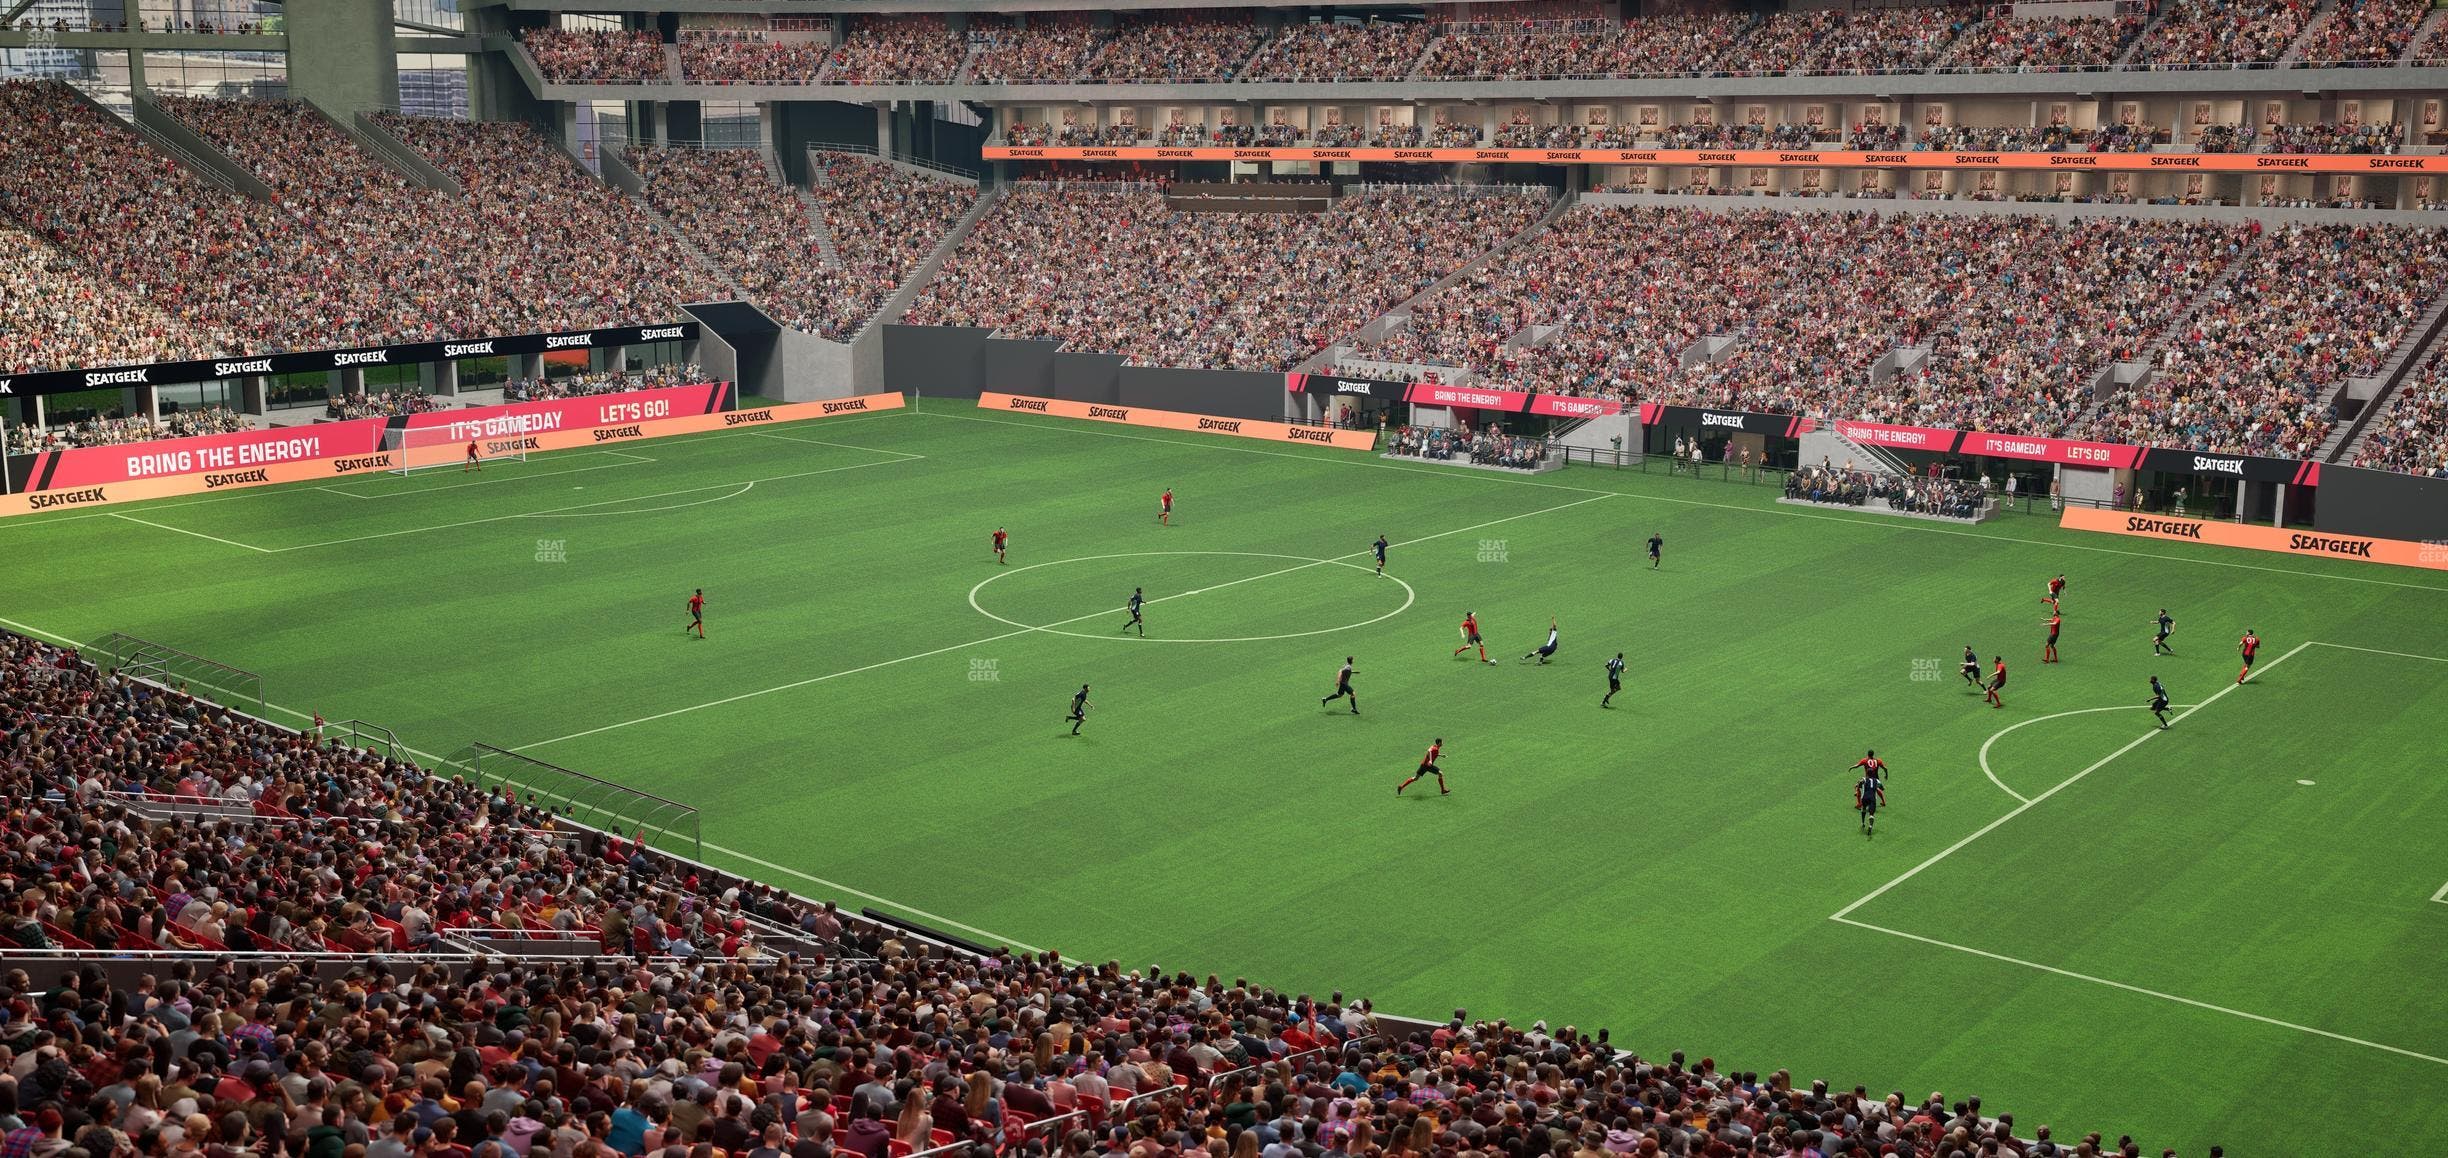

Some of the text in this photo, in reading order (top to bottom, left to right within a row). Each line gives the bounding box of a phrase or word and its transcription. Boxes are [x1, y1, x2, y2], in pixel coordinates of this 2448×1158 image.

[1009, 149, 1044, 157] SEATGEEK
[1082, 149, 1118, 157] SEATGEEK
[1157, 149, 1193, 158] SEATGEEK
[1234, 150, 1271, 158] SEATGEEK
[1313, 150, 1351, 158] SEATGEEK
[1393, 151, 1433, 159] SEATGEEK
[1476, 151, 1510, 160] SEATGEEK
[1546, 151, 1581, 160] SEATGEEK
[1620, 152, 1657, 161] SEATGEEK
[1698, 152, 1736, 162] SEATGEEK
[1779, 153, 1819, 163] SEATGEEK
[1865, 154, 1907, 164] SEATGEEK
[1955, 155, 2000, 165] SEATGEEK
[2050, 155, 2097, 166] SEATGEEK
[2150, 156, 2200, 167] SEATGEEK
[2256, 157, 2309, 168] SEATGEEK
[2369, 158, 2425, 169] SEATGEEK
[546, 333, 593, 349] SEATGEEK
[640, 326, 684, 341] SEATGEEK
[444, 341, 494, 357] SEATGEEK
[334, 350, 388, 366] SEATGEEK
[215, 358, 273, 376] SEATGEEK
[85, 368, 148, 387] SEATGEEK
[1337, 380, 1371, 395] SEATGEEK
[1010, 397, 1048, 412] SEATGEEK
[1434, 390, 1502, 406] BRING THE ENERGY!
[600, 399, 669, 423] LET'S GO!
[822, 399, 868, 414] SEATGEEK
[1088, 406, 1129, 421] SEATGEEK
[1552, 400, 1567, 412] IT'S
[450, 410, 563, 440] IT'S GAMEDAY
[724, 409, 774, 426] SEATGEEK
[1702, 412, 1745, 429] SEATGEEK
[593, 424, 643, 442] SEATGEEK
[1197, 417, 1242, 434] SEATGEEK
[1287, 427, 1335, 444] SEATGEEK
[1846, 427, 1926, 445] BRING THE ENERGY!
[1986, 439, 2047, 456] IT'S GAMEDAY
[2067, 446, 2110, 462] LET'S GO!
[127, 437, 320, 477] BRING THE ENERGY!
[2193, 456, 2244, 475] SEATGEEK
[204, 468, 270, 489] SEATGEEK
[28, 487, 107, 510] SEATGEEK
[2126, 516, 2203, 540] SEATGEEK
[2289, 533, 2373, 559] SEATGEEK
